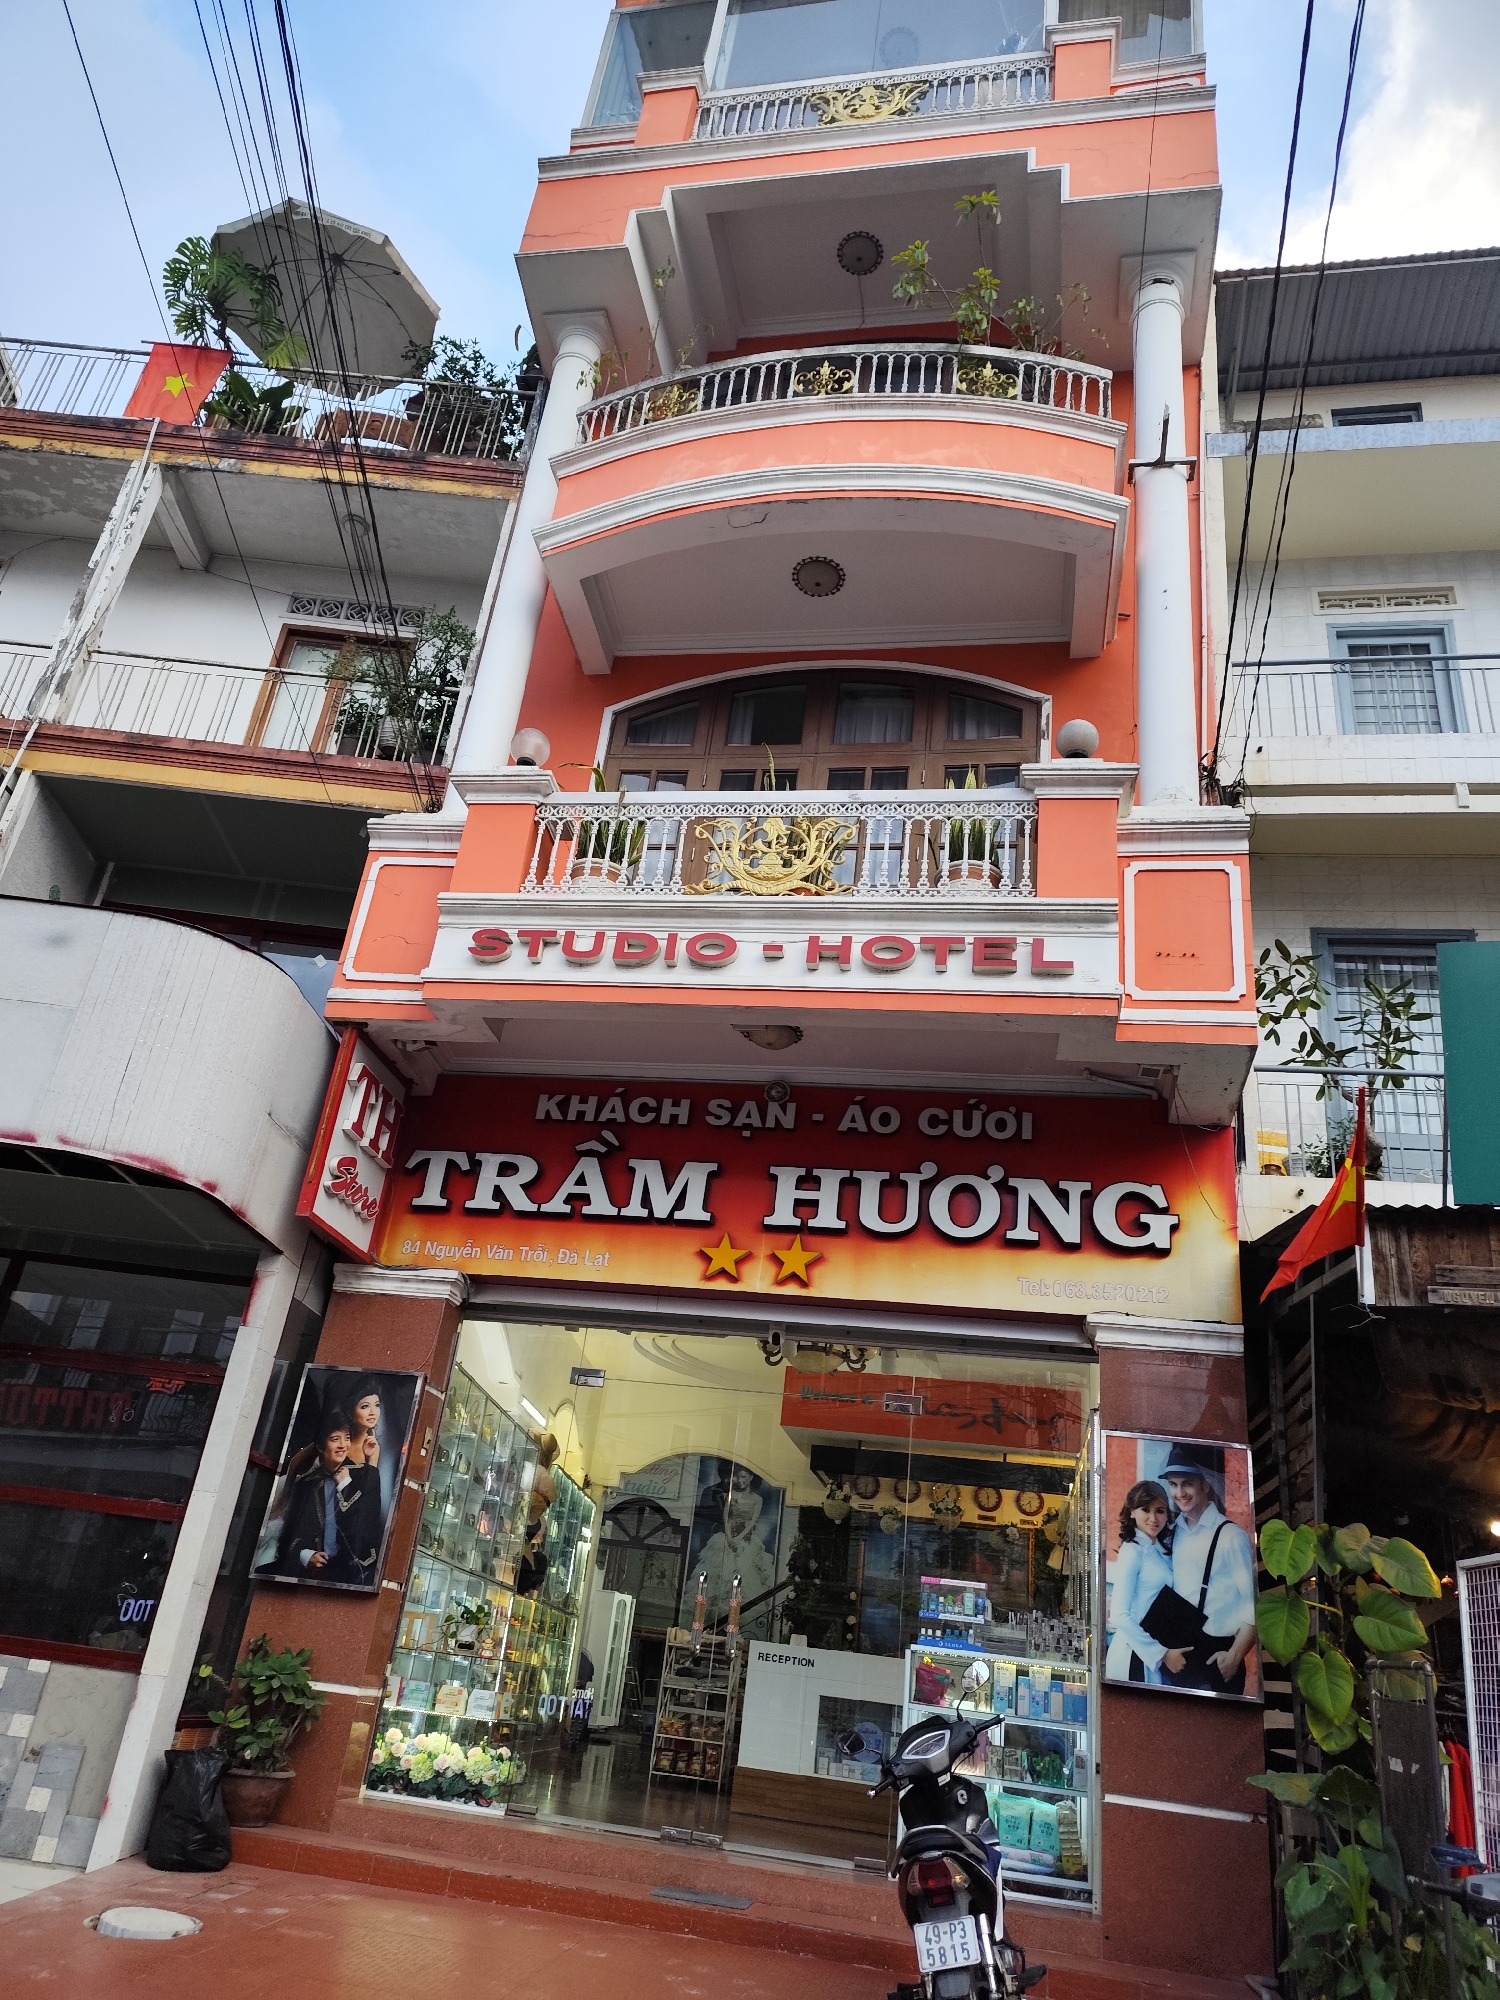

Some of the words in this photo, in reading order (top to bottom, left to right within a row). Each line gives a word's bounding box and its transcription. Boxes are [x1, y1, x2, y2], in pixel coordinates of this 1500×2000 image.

[468, 928, 738, 968] STUDIO
[763, 943, 785, 959] -
[806, 935, 1075, 975] HOTEL
[346, 1063, 404, 1168] TH
[535, 1087, 690, 1126] KHÁCH
[705, 1098, 797, 1138] SẠN
[837, 1096, 901, 1135] ÁO
[326, 1155, 379, 1219] Store
[405, 1130, 718, 1224] TRẦM
[763, 1162, 1181, 1254] HƯƠNG
[402, 1239, 421, 1255] 84
[424, 1239, 481, 1261] Nguyễn
[486, 1244, 514, 1261] Văn
[557, 1248, 578, 1265] Đà
[584, 1249, 611, 1271] Lạt
[1018, 1277, 1050, 1296] Tel:
[1053, 1280, 1170, 1304] 063.3520212
[758, 1651, 815, 1668] RECEPTION
[924, 1920, 967, 1946] 49-P3
[925, 1941, 971, 1967] 5815
